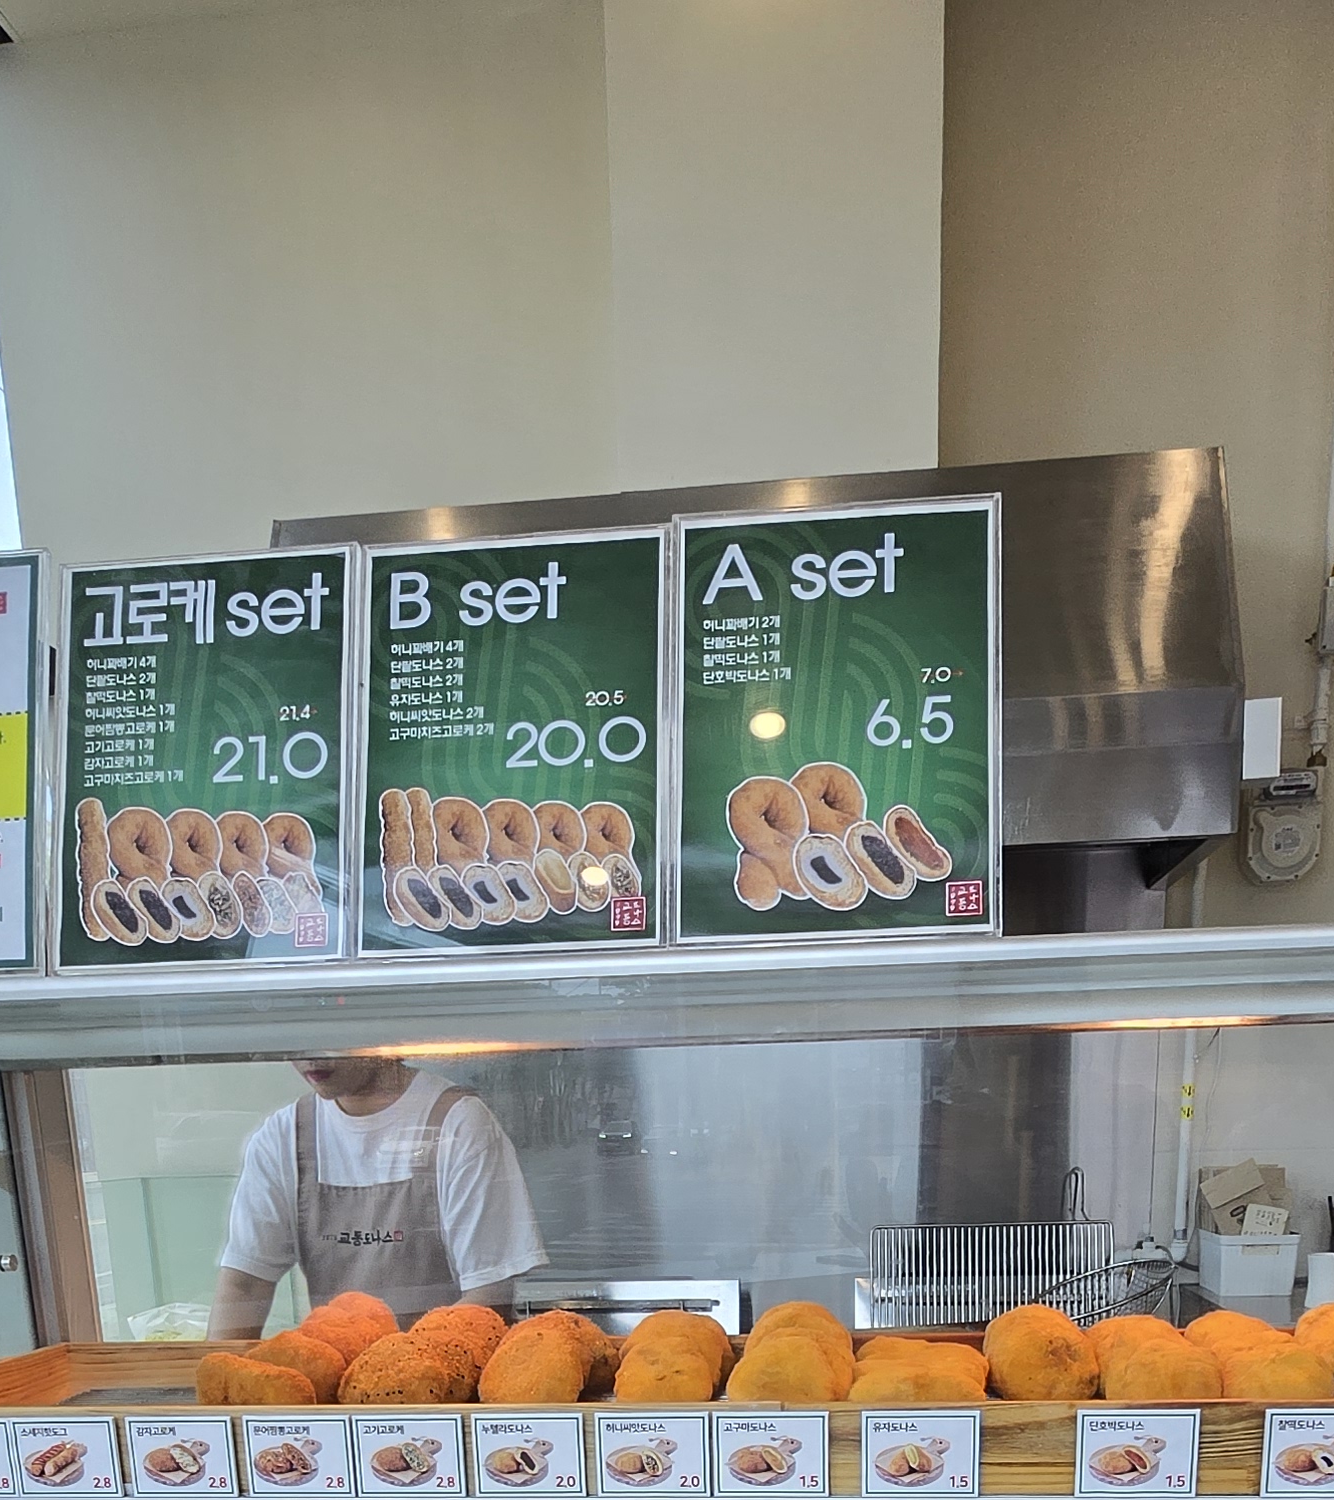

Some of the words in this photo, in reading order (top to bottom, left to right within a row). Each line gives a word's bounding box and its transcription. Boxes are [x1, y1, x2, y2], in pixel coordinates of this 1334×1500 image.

[702, 544, 764, 605] A
[790, 532, 905, 600] set
[390, 572, 432, 630] B
[459, 561, 567, 627] set
[83, 578, 216, 647] 고로케
[225, 572, 330, 639] set
[761, 615, 780, 628] 2개
[445, 639, 464, 652] 4개
[762, 632, 780, 645] 1개
[139, 655, 157, 668] 4개
[445, 656, 464, 669] 2개
[762, 650, 780, 663] 1개
[139, 672, 157, 685] 2개
[445, 673, 463, 686] 2개
[703, 668, 770, 685] 단호박도나스
[773, 667, 791, 680] 1개
[921, 666, 952, 684] 7.0
[139, 688, 156, 701] 1개
[389, 691, 443, 707] 유자도나스
[446, 690, 463, 703] 1개
[585, 690, 625, 708] 20.5
[159, 703, 176, 716] 1개
[279, 704, 312, 722] 21.4
[389, 707, 463, 724] 허니씨앗도나스
[465, 706, 484, 719] 2개
[159, 720, 175, 733] 1개
[866, 694, 955, 750] 6.5
[389, 724, 474, 740] 고구마치즈고로케
[476, 722, 495, 736] 2개
[84, 739, 135, 754] 고기고로케
[138, 738, 155, 750] 1개
[506, 716, 648, 769] 20.0
[84, 755, 135, 771] 감자고로케
[138, 754, 154, 767] 1개
[213, 731, 329, 784] 21.0
[84, 771, 165, 787] 고구마치즈고로케
[167, 769, 184, 782] 1개
[337, 1229, 394, 1247] 교동도나스
[136, 1426, 177, 1437] 감자고로케
[363, 1425, 405, 1435] 고기고로케
[481, 1423, 533, 1434] 누텔라도나스
[606, 1422, 666, 1434] 허니씨앗도나스
[723, 1422, 777, 1432] 고구마도나스
[873, 1422, 918, 1433] 유자도나스
[1089, 1420, 1145, 1432] 단호박도나스
[1278, 1419, 1325, 1431] 찰떡도나스
[93, 1477, 112, 1490] 2.8
[208, 1476, 228, 1490] 2.8
[325, 1476, 345, 1490] 2.8
[436, 1476, 455, 1490] 2.8
[555, 1475, 576, 1489] 2.0
[679, 1476, 700, 1489] 2.0
[799, 1475, 819, 1489] 1.5
[949, 1475, 969, 1489] 1.5
[1165, 1475, 1186, 1489] 1.5
